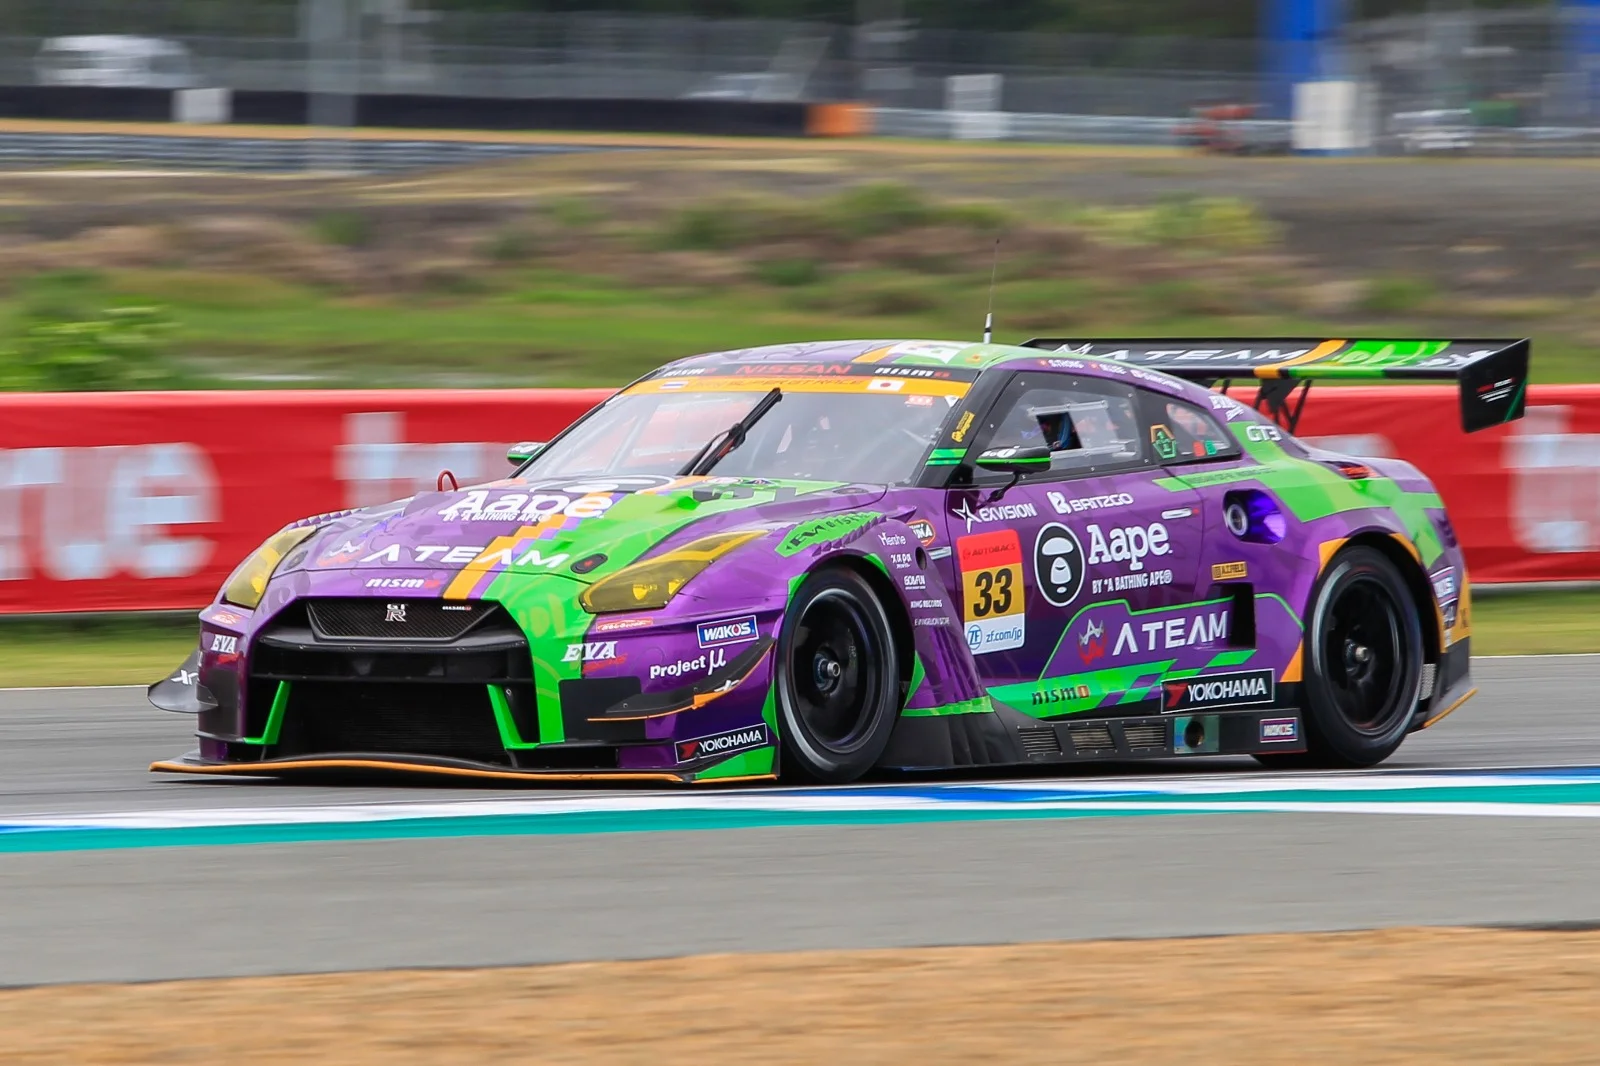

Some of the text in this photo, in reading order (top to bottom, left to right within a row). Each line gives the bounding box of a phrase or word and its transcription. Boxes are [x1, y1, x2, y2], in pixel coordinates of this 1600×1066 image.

[1144, 350, 1309, 360] TEAM
[735, 365, 852, 376] NISSAN
[1246, 425, 1282, 442] GT3
[0, 443, 224, 581] rue
[471, 511, 518, 521] BATHING
[978, 502, 1038, 523] EXVISION
[360, 543, 570, 568] A TEAM
[972, 542, 1016, 556] AUTOBACS
[365, 578, 440, 588] nismo
[973, 567, 1013, 617] 33
[1092, 579, 1103, 594] BY
[1115, 573, 1149, 590] BATHING
[968, 626, 1022, 646] ZF zf.com/jp
[1112, 610, 1228, 656] A TEAM
[210, 634, 238, 654] EVA
[560, 641, 618, 661] EVA
[1031, 684, 1089, 705] nismo
[1187, 678, 1267, 703] YOKOHAMA
[698, 729, 762, 753] YOKOHAMA
